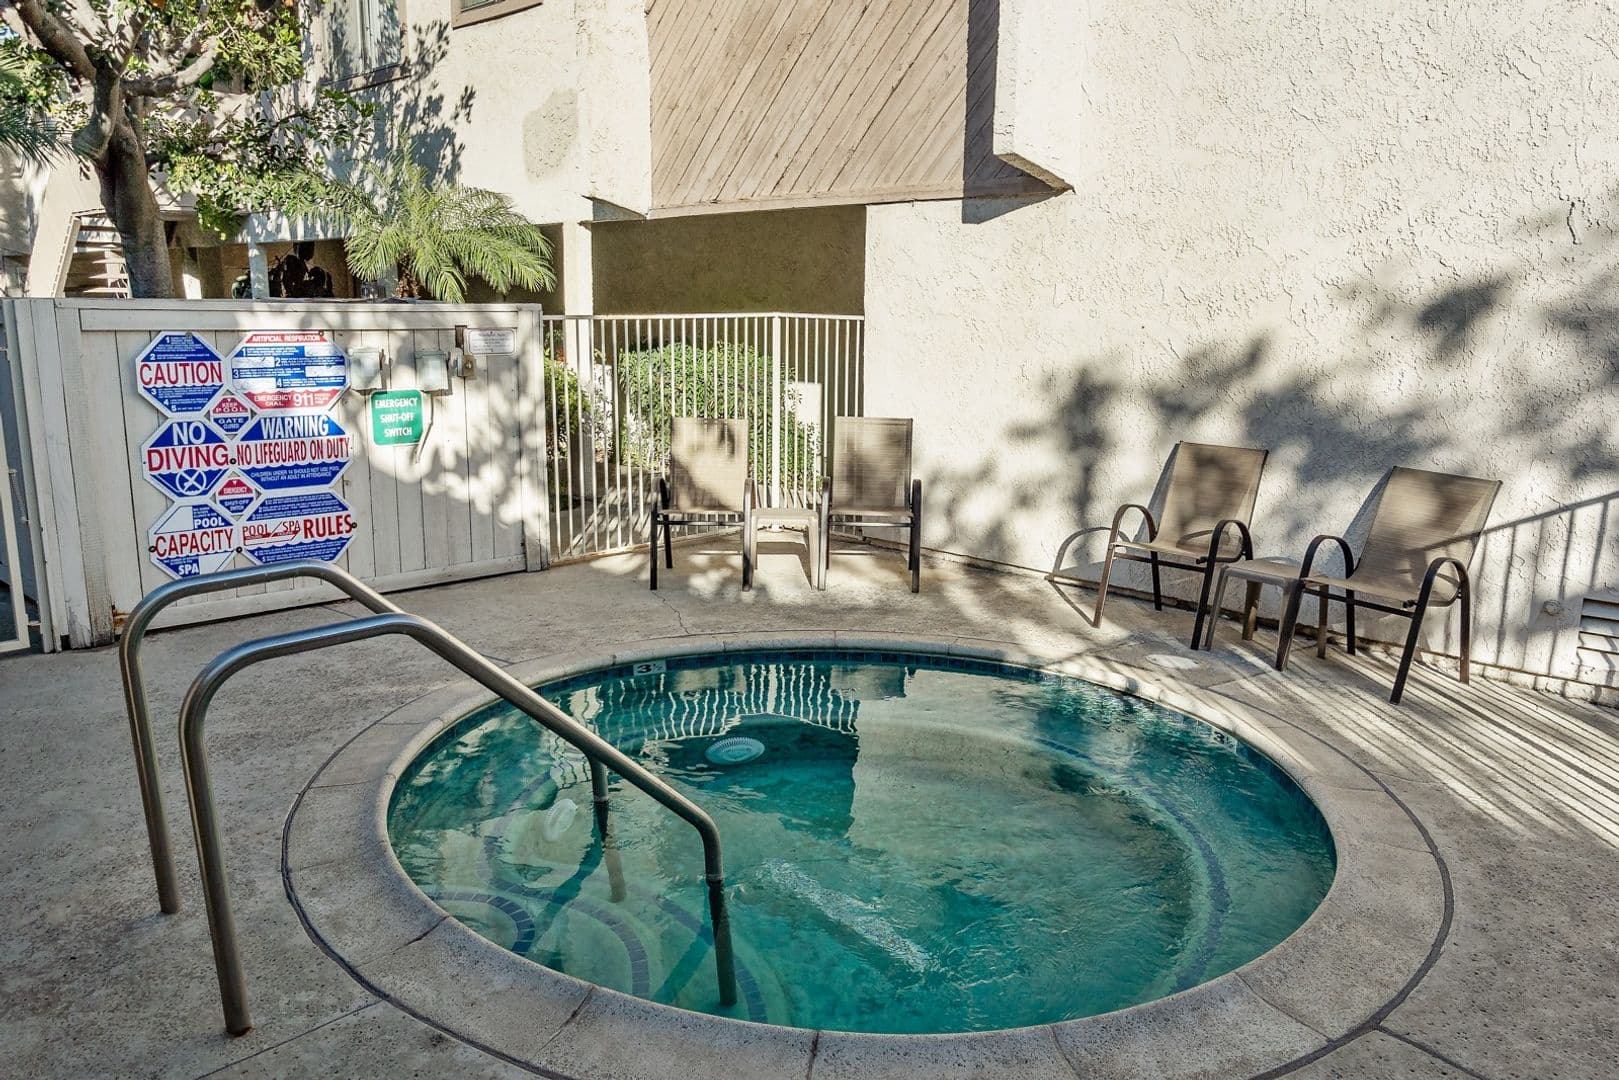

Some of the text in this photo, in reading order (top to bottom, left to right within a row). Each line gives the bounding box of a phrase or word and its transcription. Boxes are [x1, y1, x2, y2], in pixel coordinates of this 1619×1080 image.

[166, 336, 170, 344] 1
[275, 358, 281, 366] 2
[140, 362, 223, 386] CAUTION
[233, 369, 239, 378] 3
[277, 379, 283, 388] 4
[254, 393, 292, 402] EMERGENCY
[293, 393, 314, 406] 911
[375, 397, 418, 409] EMERGENCY
[380, 412, 415, 424] SHUT-OFF
[172, 421, 206, 446] NO
[261, 415, 329, 440] WARNING
[384, 426, 412, 438] SWITCH
[236, 437, 350, 466] NO LIFEGUARD ON DUTY
[147, 444, 229, 472] DIVING
[194, 517, 225, 529] POOL
[242, 523, 268, 535] POOL
[282, 520, 301, 532] SPA
[303, 514, 353, 539] RULES
[155, 528, 234, 557] CAPACITY
[178, 563, 200, 575] SPA
